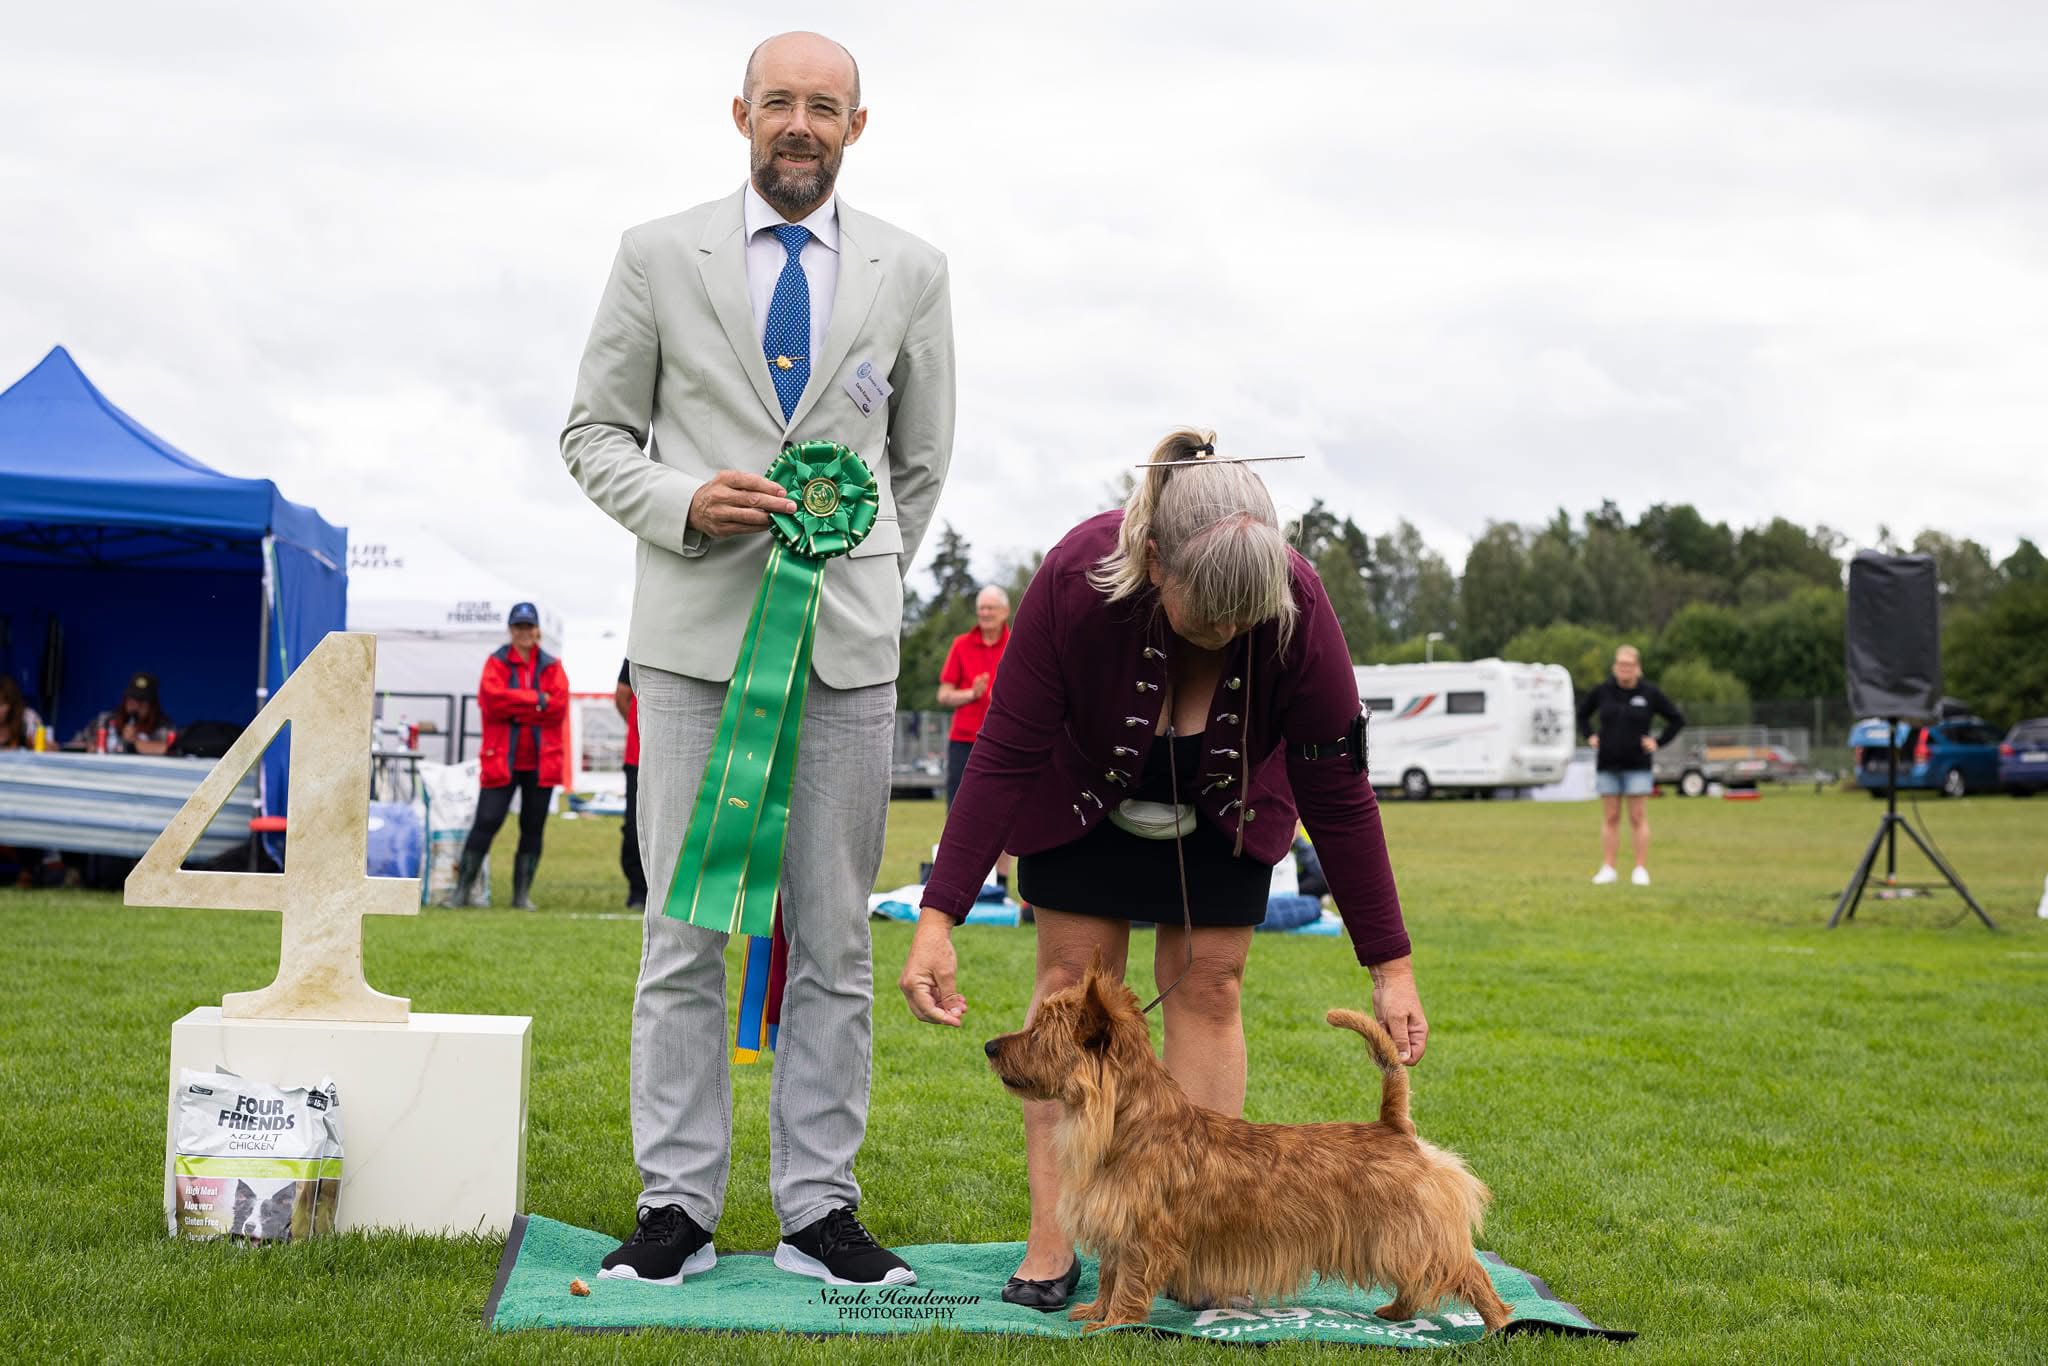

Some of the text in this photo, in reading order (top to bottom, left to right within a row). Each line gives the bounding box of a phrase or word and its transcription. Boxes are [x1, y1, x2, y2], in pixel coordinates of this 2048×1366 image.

[124, 632, 421, 1023] 4
[236, 1094, 284, 1116] FOUR
[217, 1109, 295, 1131] FRIENDS
[230, 1133, 284, 1143] ADULT
[228, 1141, 275, 1151] CHICKEN
[185, 1184, 218, 1197] High Meat
[184, 1200, 198, 1211] Aloe
